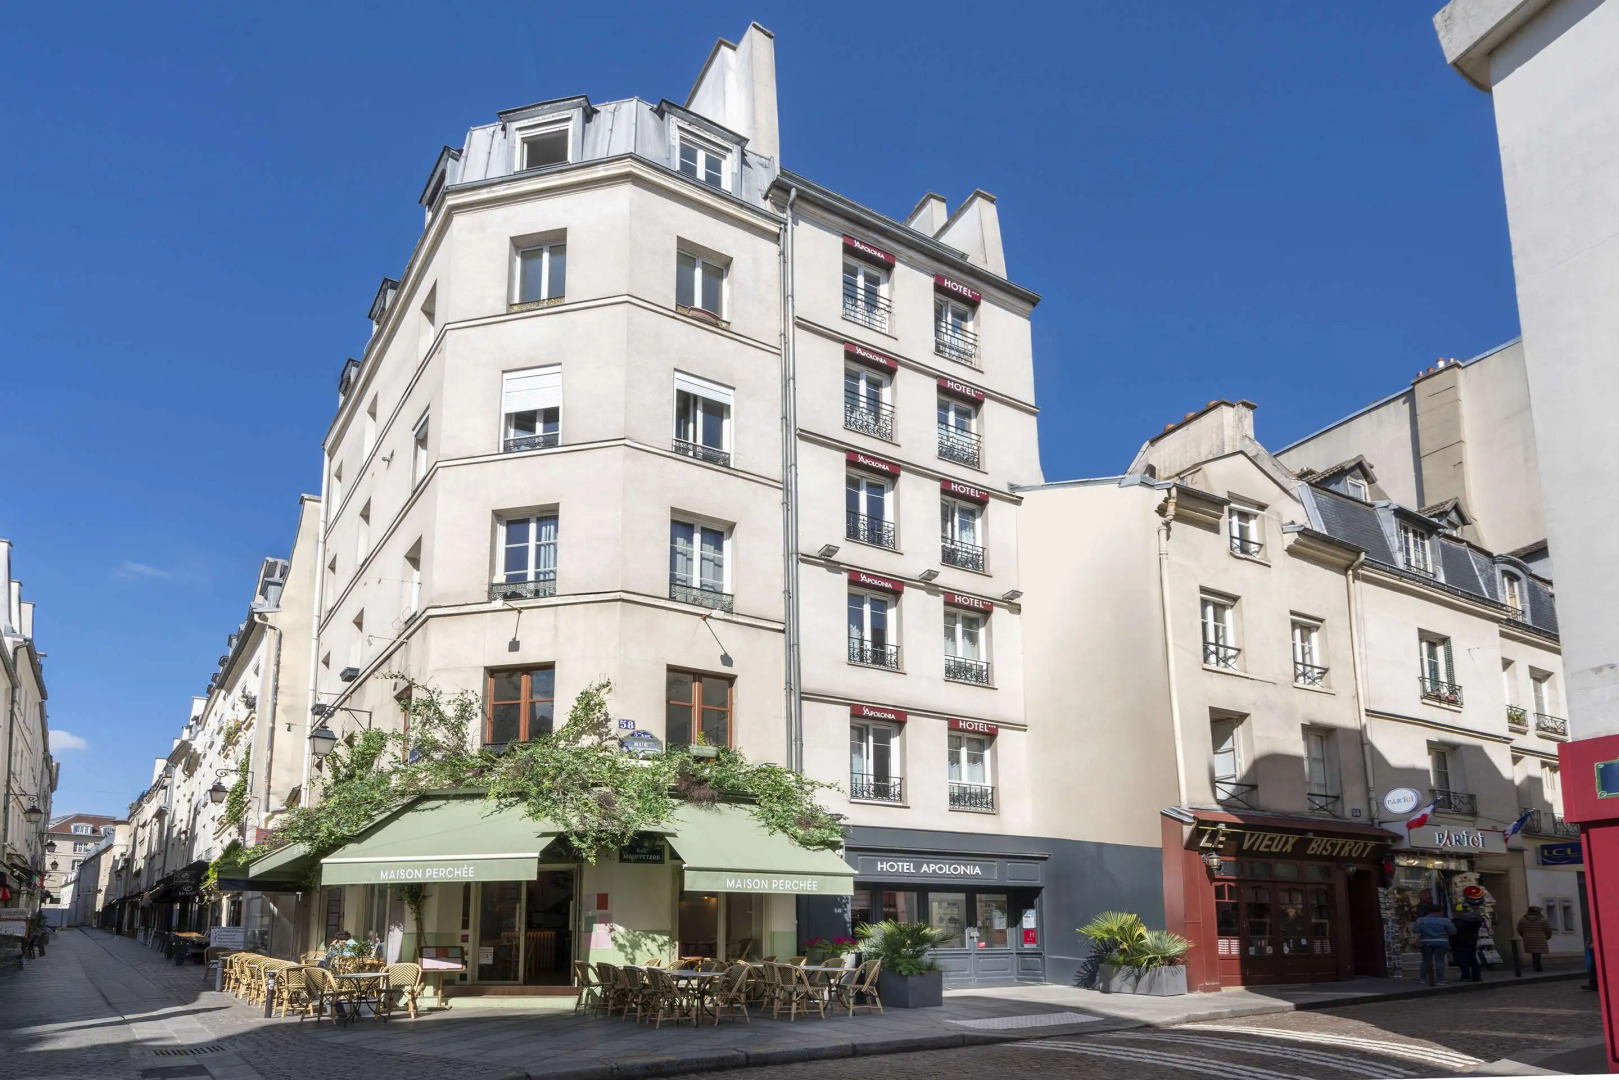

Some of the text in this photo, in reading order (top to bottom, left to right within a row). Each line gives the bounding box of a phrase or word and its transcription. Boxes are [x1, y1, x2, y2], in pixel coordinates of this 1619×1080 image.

[944, 278, 973, 298] HOTEL
[947, 380, 976, 397] HOTEL
[951, 482, 980, 499] HOTEL
[954, 594, 984, 609] HOTEL
[619, 720, 635, 729] 58
[958, 720, 989, 732] HOTEL
[1199, 829, 1376, 858] LE VIEUX BISTROT
[1543, 847, 1578, 857] LCL
[380, 865, 475, 880] MAISON PERCHÉE
[877, 861, 982, 876] HOTEL APOLONIA
[726, 878, 818, 891] MAISON PERCHÉE
